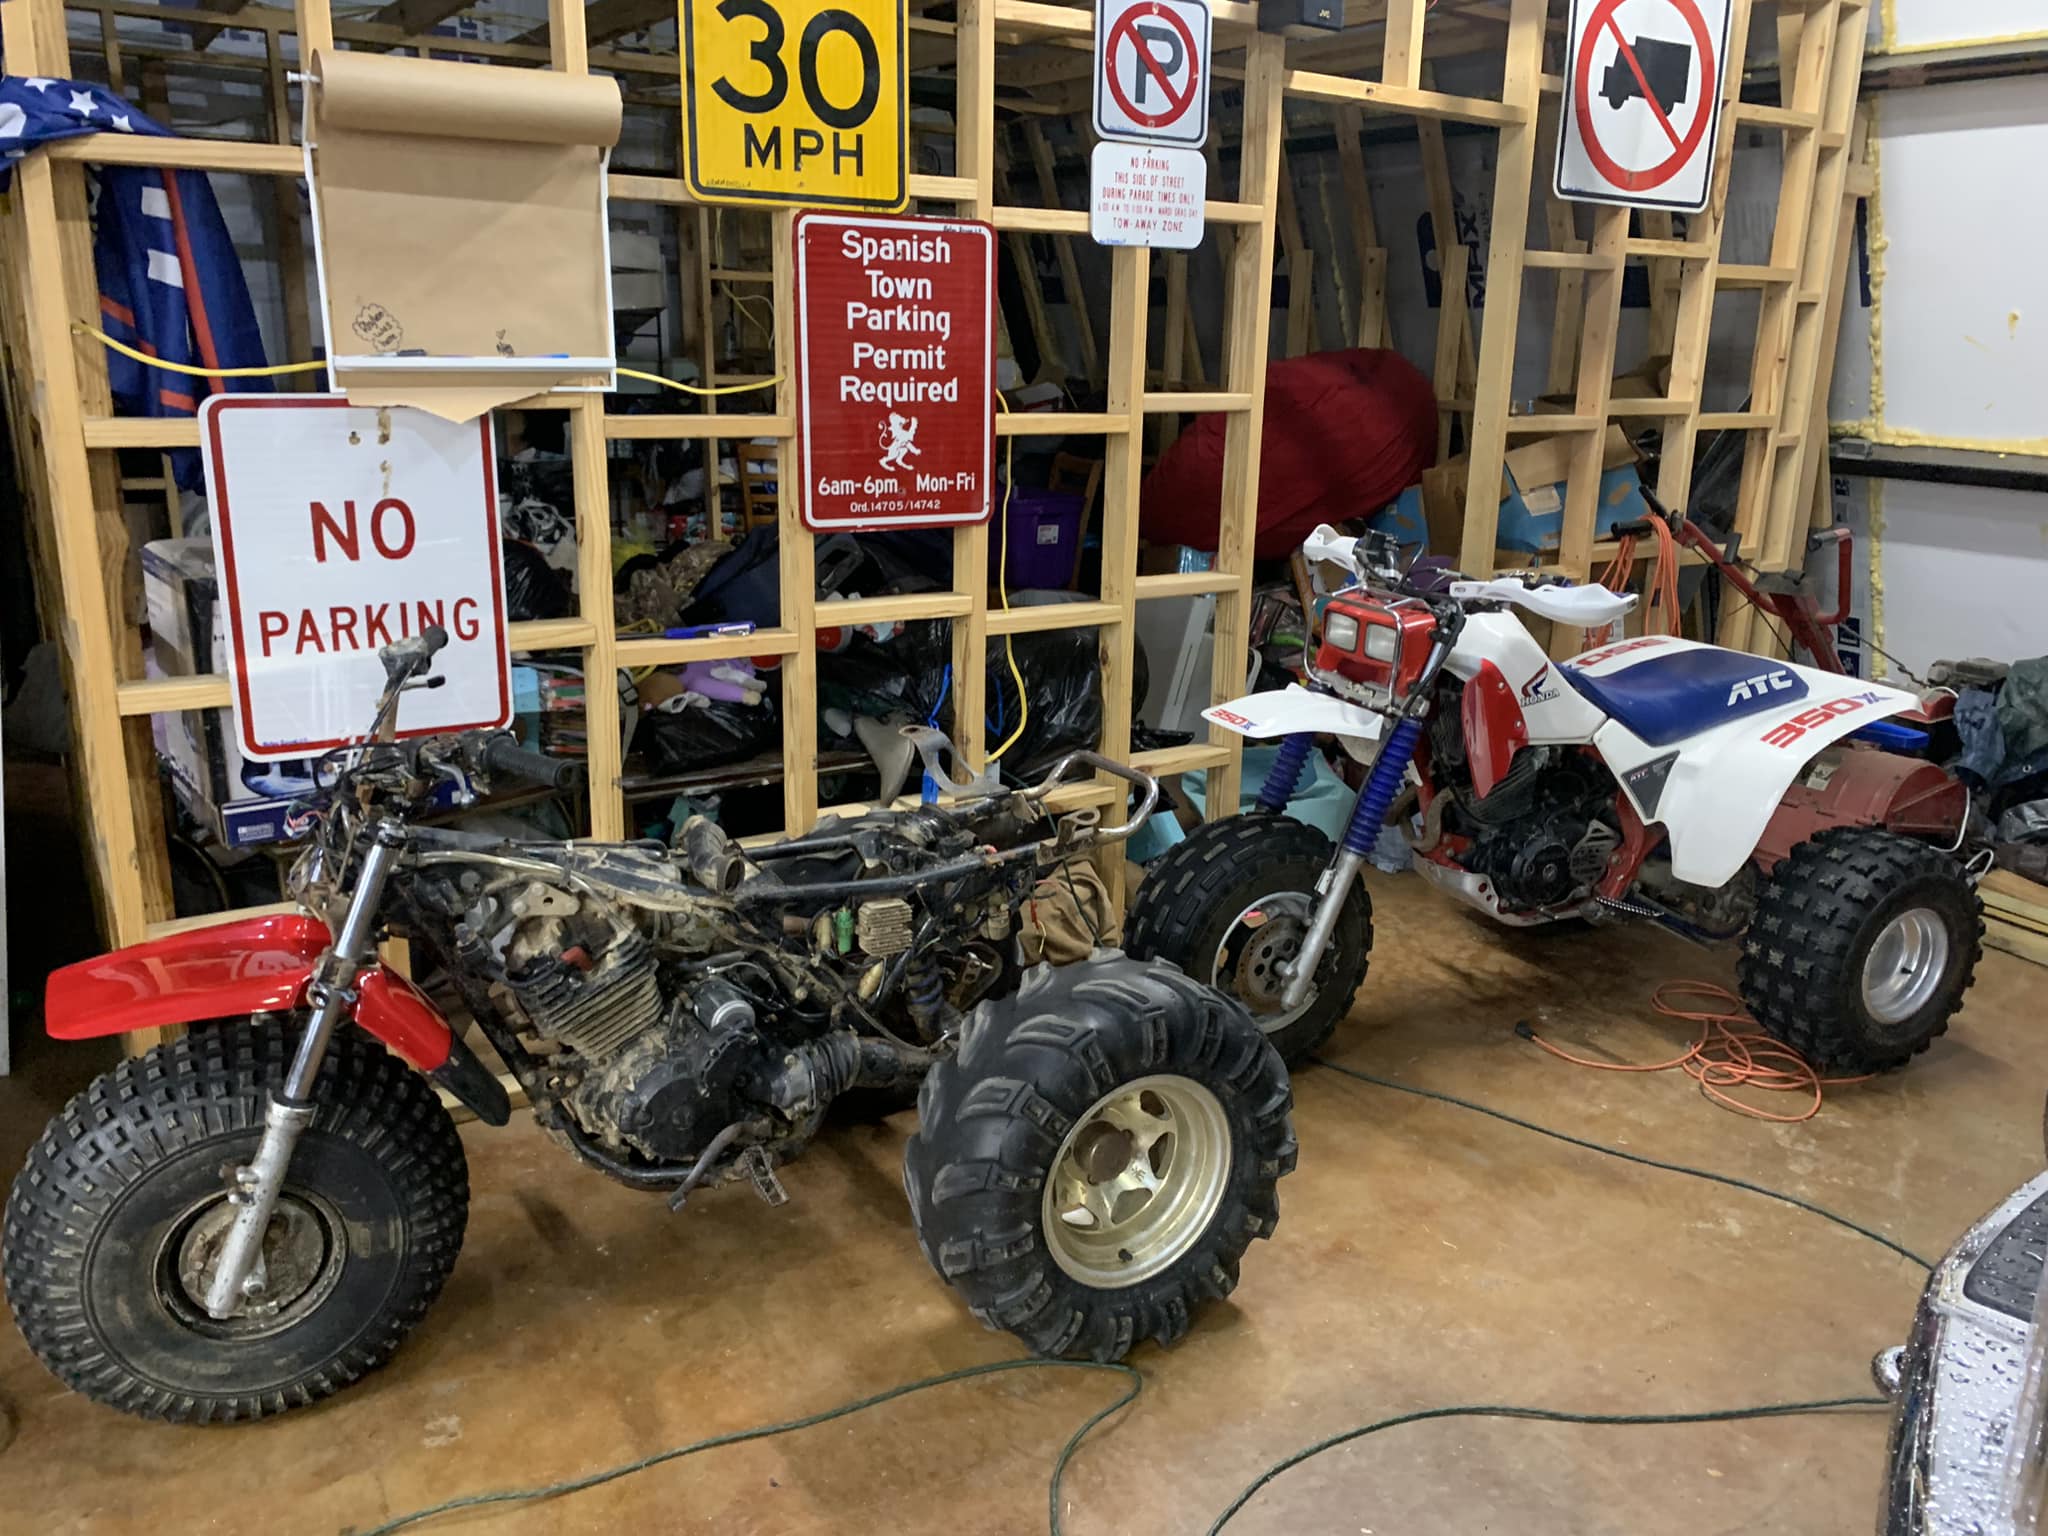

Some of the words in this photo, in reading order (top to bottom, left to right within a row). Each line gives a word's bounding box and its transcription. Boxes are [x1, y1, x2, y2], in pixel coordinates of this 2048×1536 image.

[711, 0, 880, 129] 30
[1135, 24, 1184, 104] P
[744, 123, 863, 177] MPH
[1130, 157, 1139, 169] NO
[1143, 158, 1170, 171] PARKING
[1102, 186, 1125, 199] DURING
[1129, 188, 1153, 202] PARADE
[1158, 191, 1175, 204] TIMES
[1180, 193, 1195, 205] ONLY
[1114, 171, 1128, 184] THIS
[1133, 173, 1146, 186] SIDE
[1150, 175, 1158, 187] OF
[1162, 175, 1184, 188] STREET
[1163, 220, 1184, 232] ZONE
[841, 229, 951, 266] Spanish
[865, 269, 932, 300] Town
[847, 301, 951, 341] Parking
[853, 342, 946, 370] Permit
[840, 375, 958, 408] Required
[916, 472, 975, 493] Mon-Fri
[309, 498, 416, 563] NO
[259, 597, 480, 657] PARKING
[1520, 688, 1561, 708] HONDA
[1727, 670, 1793, 707] ATC
[1760, 692, 1895, 749] 350X
